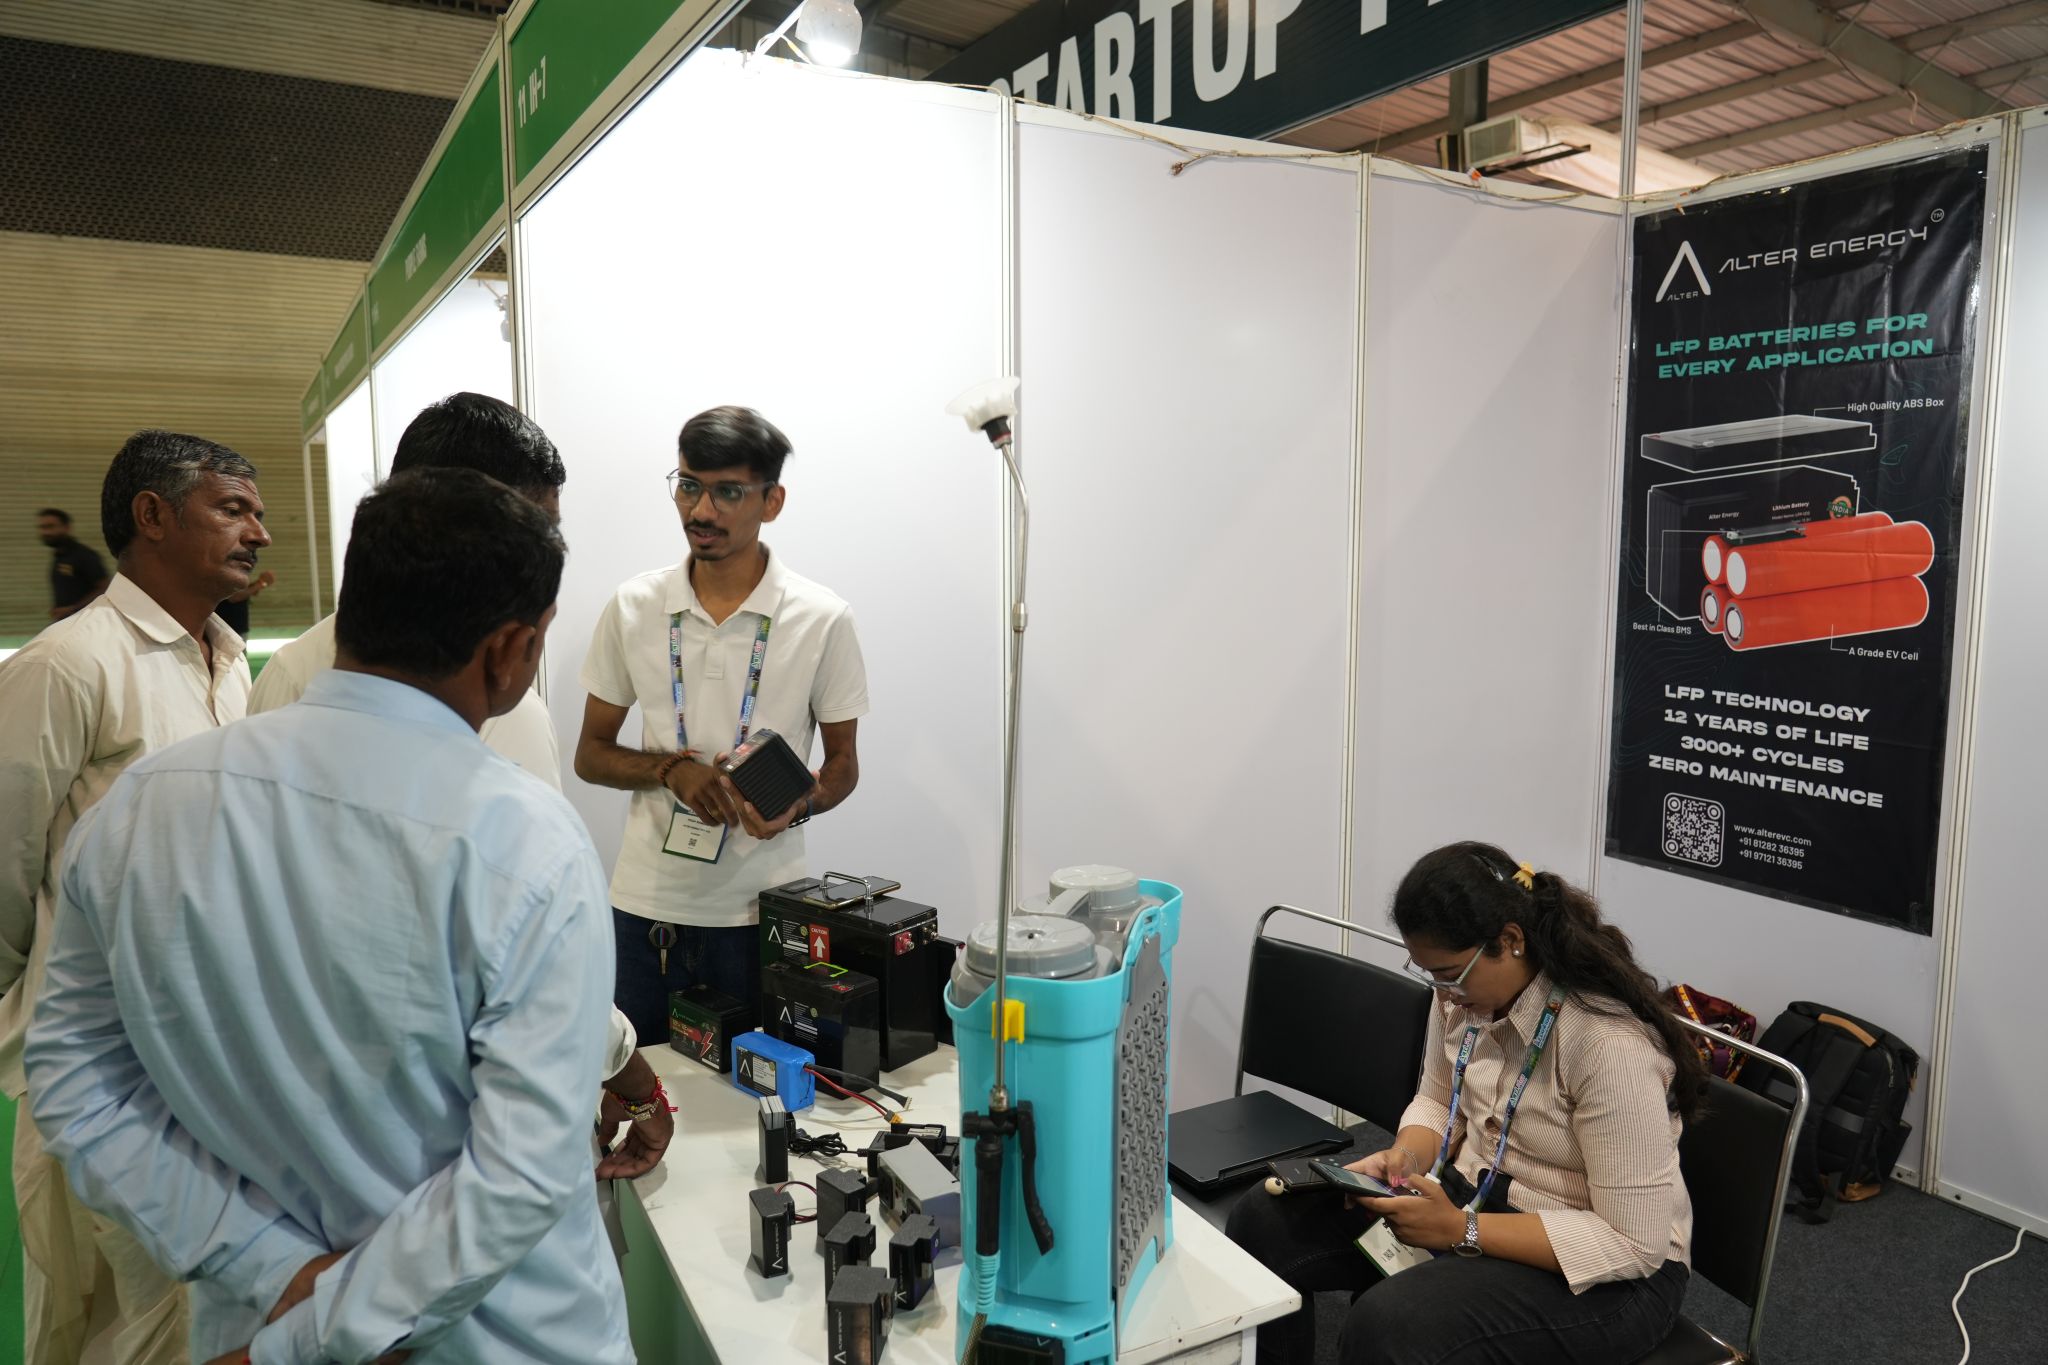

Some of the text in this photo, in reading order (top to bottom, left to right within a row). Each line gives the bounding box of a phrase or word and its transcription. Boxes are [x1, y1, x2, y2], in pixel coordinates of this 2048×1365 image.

[1719, 226, 1928, 273] ALTER ENERGY
[1667, 290, 1699, 301] ALTER
[1655, 312, 1929, 356] LFP BATTERIES FOR
[1658, 338, 1933, 379] EVERY APPLICATION
[1847, 397, 1945, 413] High Quality ABS Box
[1831, 504, 1849, 514] INDIA
[1632, 622, 1692, 635] Best in Class BMS
[1849, 647, 1919, 661] A Grade EV Cell
[1665, 684, 1871, 723] LFP TECHNOLOGY
[1664, 709, 1869, 751] 12 YEARS OF LIFE
[1681, 736, 1844, 774] 3000+ CYCLES
[1649, 754, 1883, 809] ZERO MAINTENANCE
[1733, 824, 1812, 847] www.alterevc.com
[1739, 837, 1752, 846] +91
[1739, 850, 1752, 858] +91
